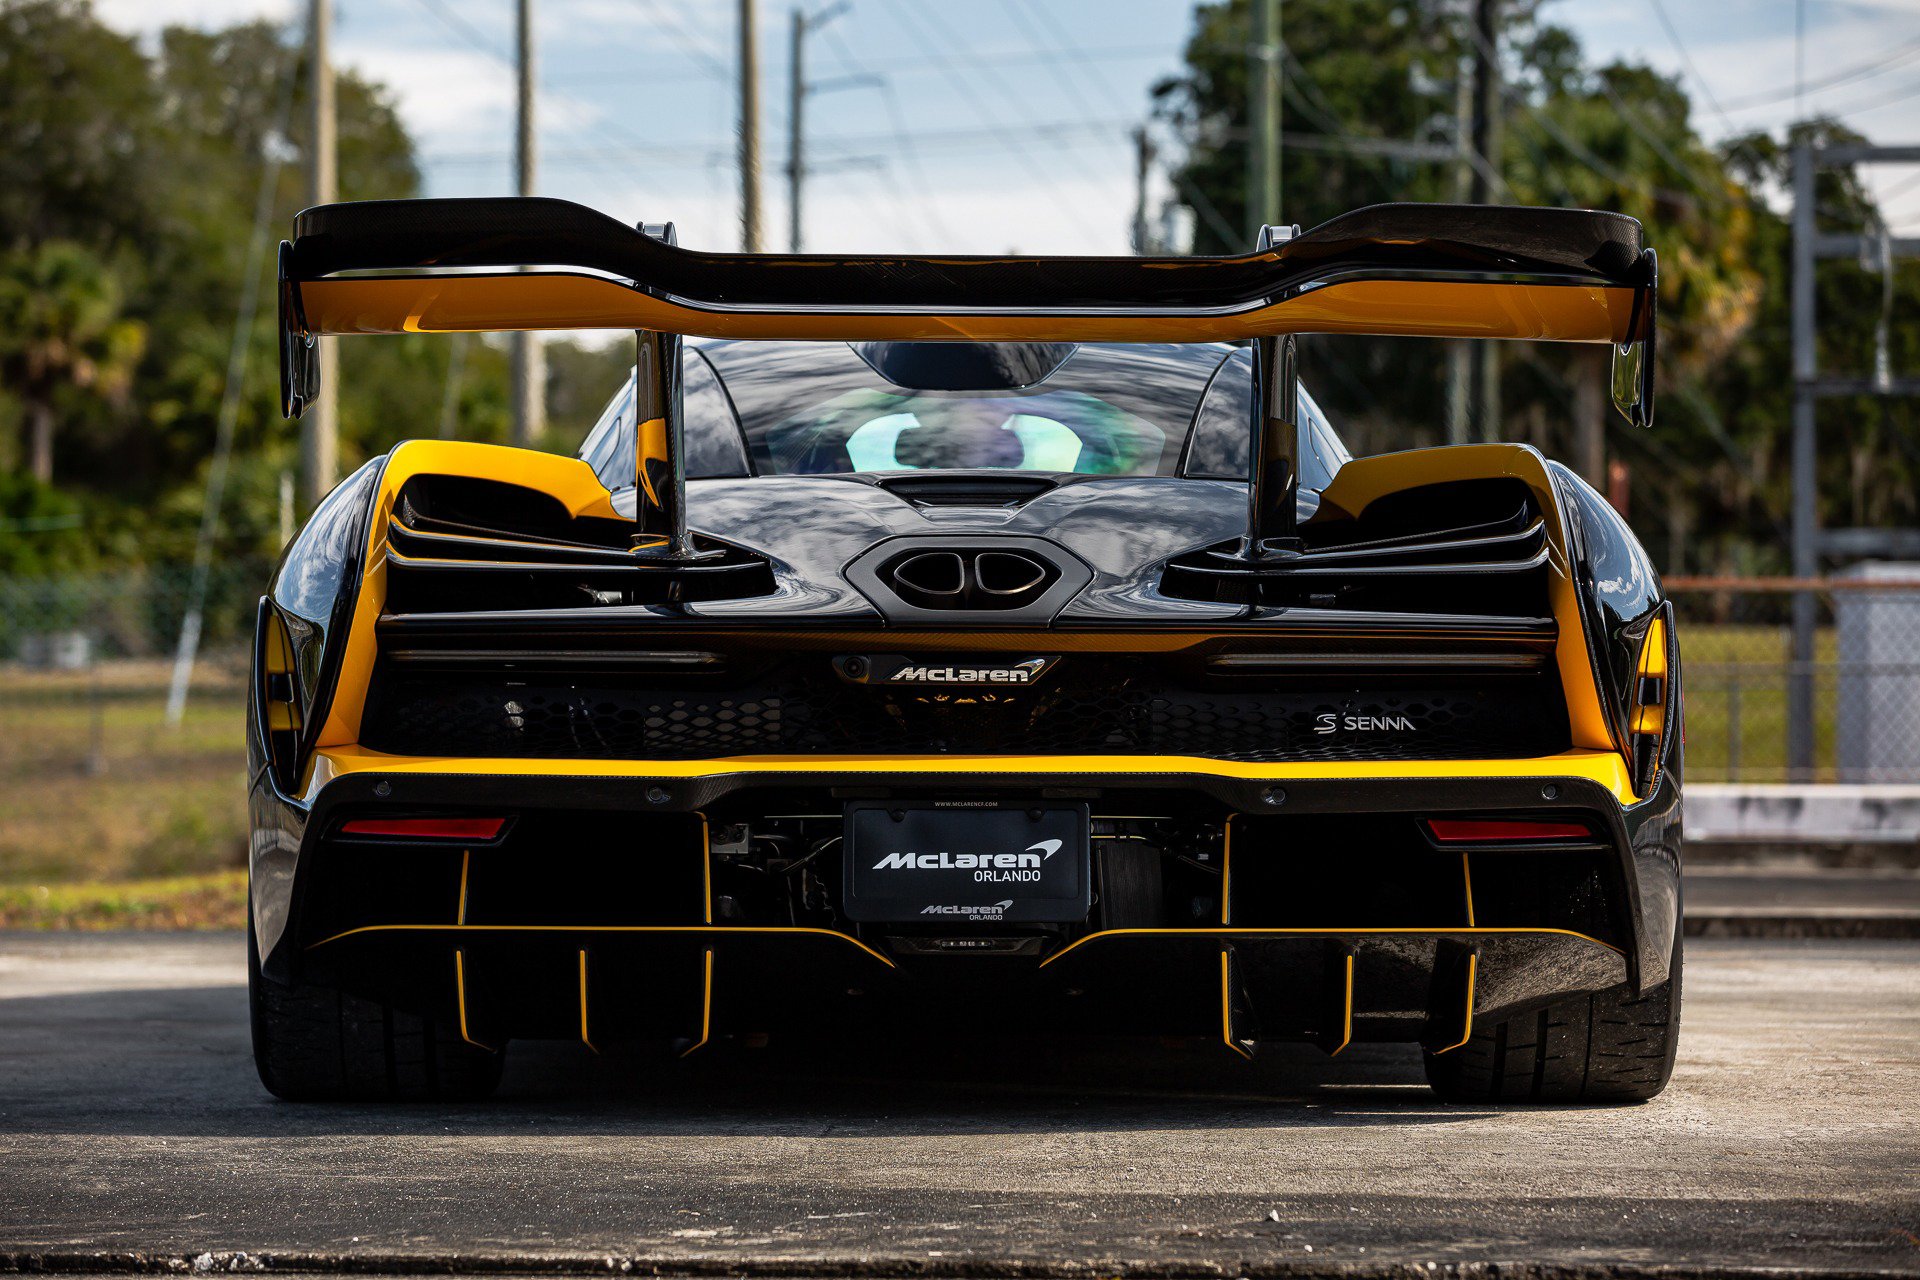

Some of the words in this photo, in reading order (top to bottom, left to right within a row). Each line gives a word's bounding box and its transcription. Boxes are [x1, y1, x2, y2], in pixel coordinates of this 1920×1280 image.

[891, 666, 1028, 682] McLaren
[1344, 717, 1416, 730] SENNA
[872, 852, 1041, 869] McLaren
[974, 870, 1041, 882] ORLANDO
[920, 905, 1003, 914] McLaren
